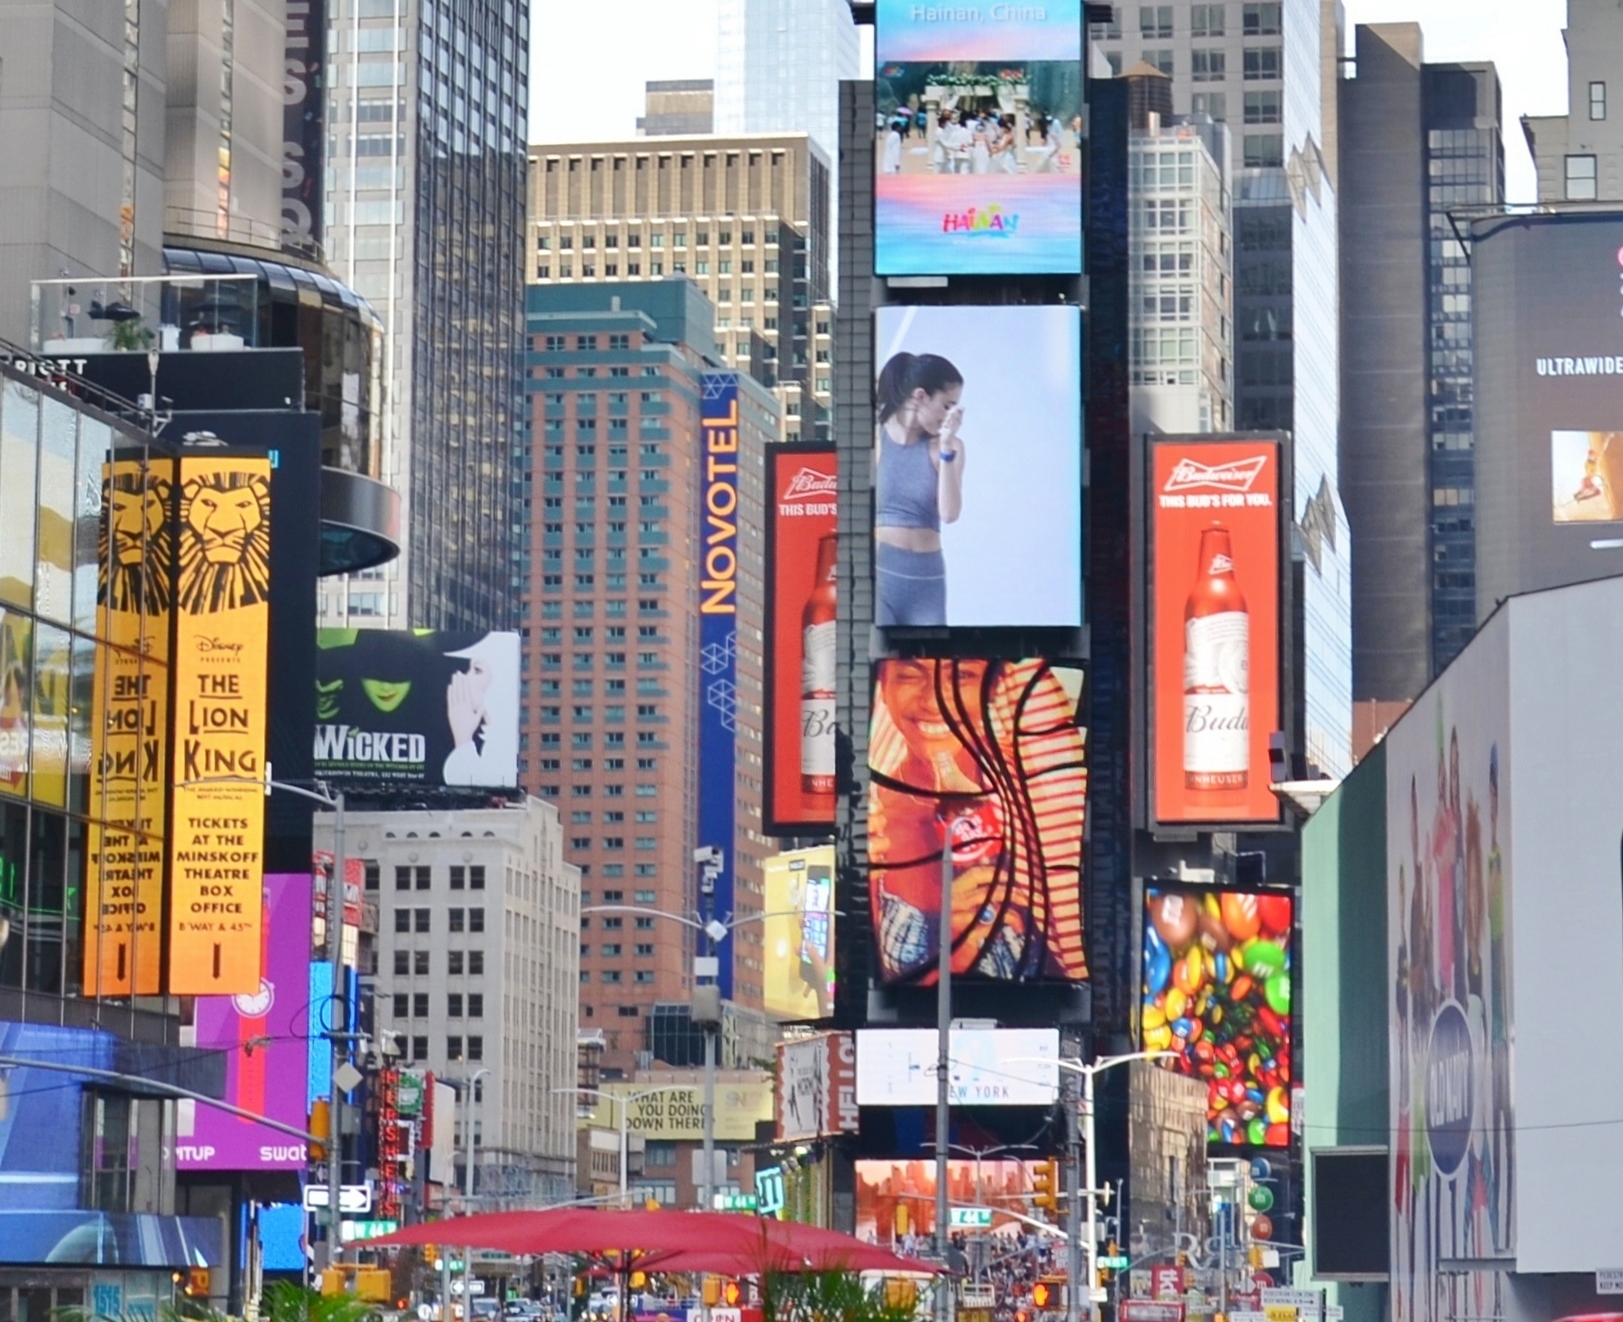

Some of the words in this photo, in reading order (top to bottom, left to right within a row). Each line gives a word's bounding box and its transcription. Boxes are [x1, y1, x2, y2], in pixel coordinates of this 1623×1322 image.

[911, 4, 985, 23] Hainan,
[990, 3, 1047, 21] China
[700, 399, 738, 614] NOVOTEL
[1159, 495, 1185, 508] THIS
[1221, 494, 1245, 507] FOR
[779, 504, 804, 516] THIS
[193, 635, 244, 656] Disney
[197, 674, 239, 693] THE
[189, 700, 249, 735] LION
[184, 739, 256, 780] KING
[188, 818, 248, 828] TICKETS
[192, 835, 211, 845] AT
[217, 835, 244, 845] THE
[176, 852, 259, 862] MINSKOFF
[184, 868, 250, 879] THEATRE
[200, 886, 234, 896] BOX
[190, 902, 243, 913] OFFICE
[218, 923, 226, 931] &
[628, 1091, 665, 1103] WHAT
[669, 1091, 694, 1103] ARE
[975, 1086, 1009, 1098] YORK
[638, 1104, 664, 1116] YOU
